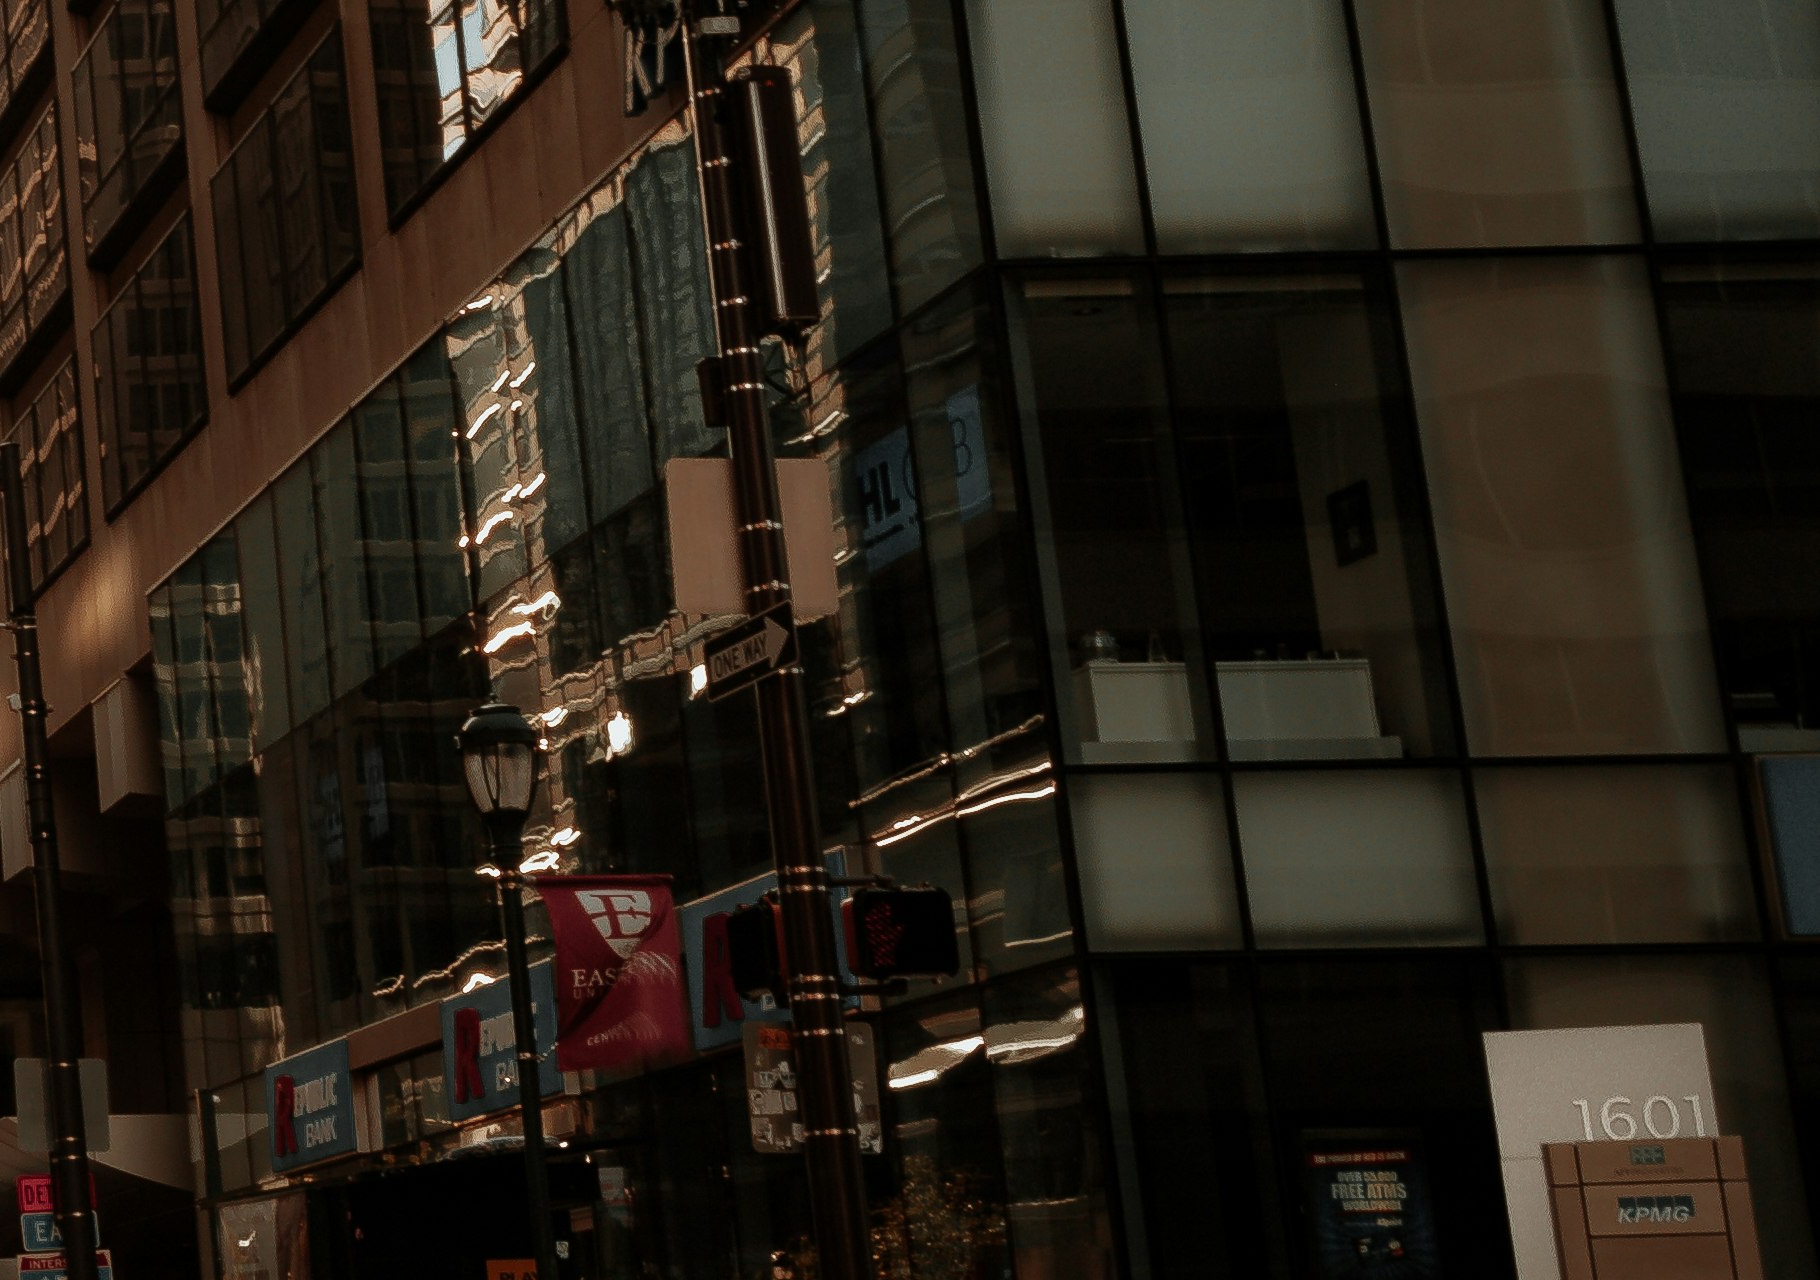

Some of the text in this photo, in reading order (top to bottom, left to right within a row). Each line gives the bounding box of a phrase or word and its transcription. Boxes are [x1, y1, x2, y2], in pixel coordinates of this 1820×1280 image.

[714, 629, 767, 677] ONE WAY
[274, 1072, 338, 1157] REPUBLIC
[1572, 1093, 1706, 1141] 1601
[305, 1115, 338, 1148] BANK
[1331, 1183, 1365, 1199] FREE
[1337, 1171, 1362, 1182] OVER
[1618, 1205, 1691, 1224] KPMG
